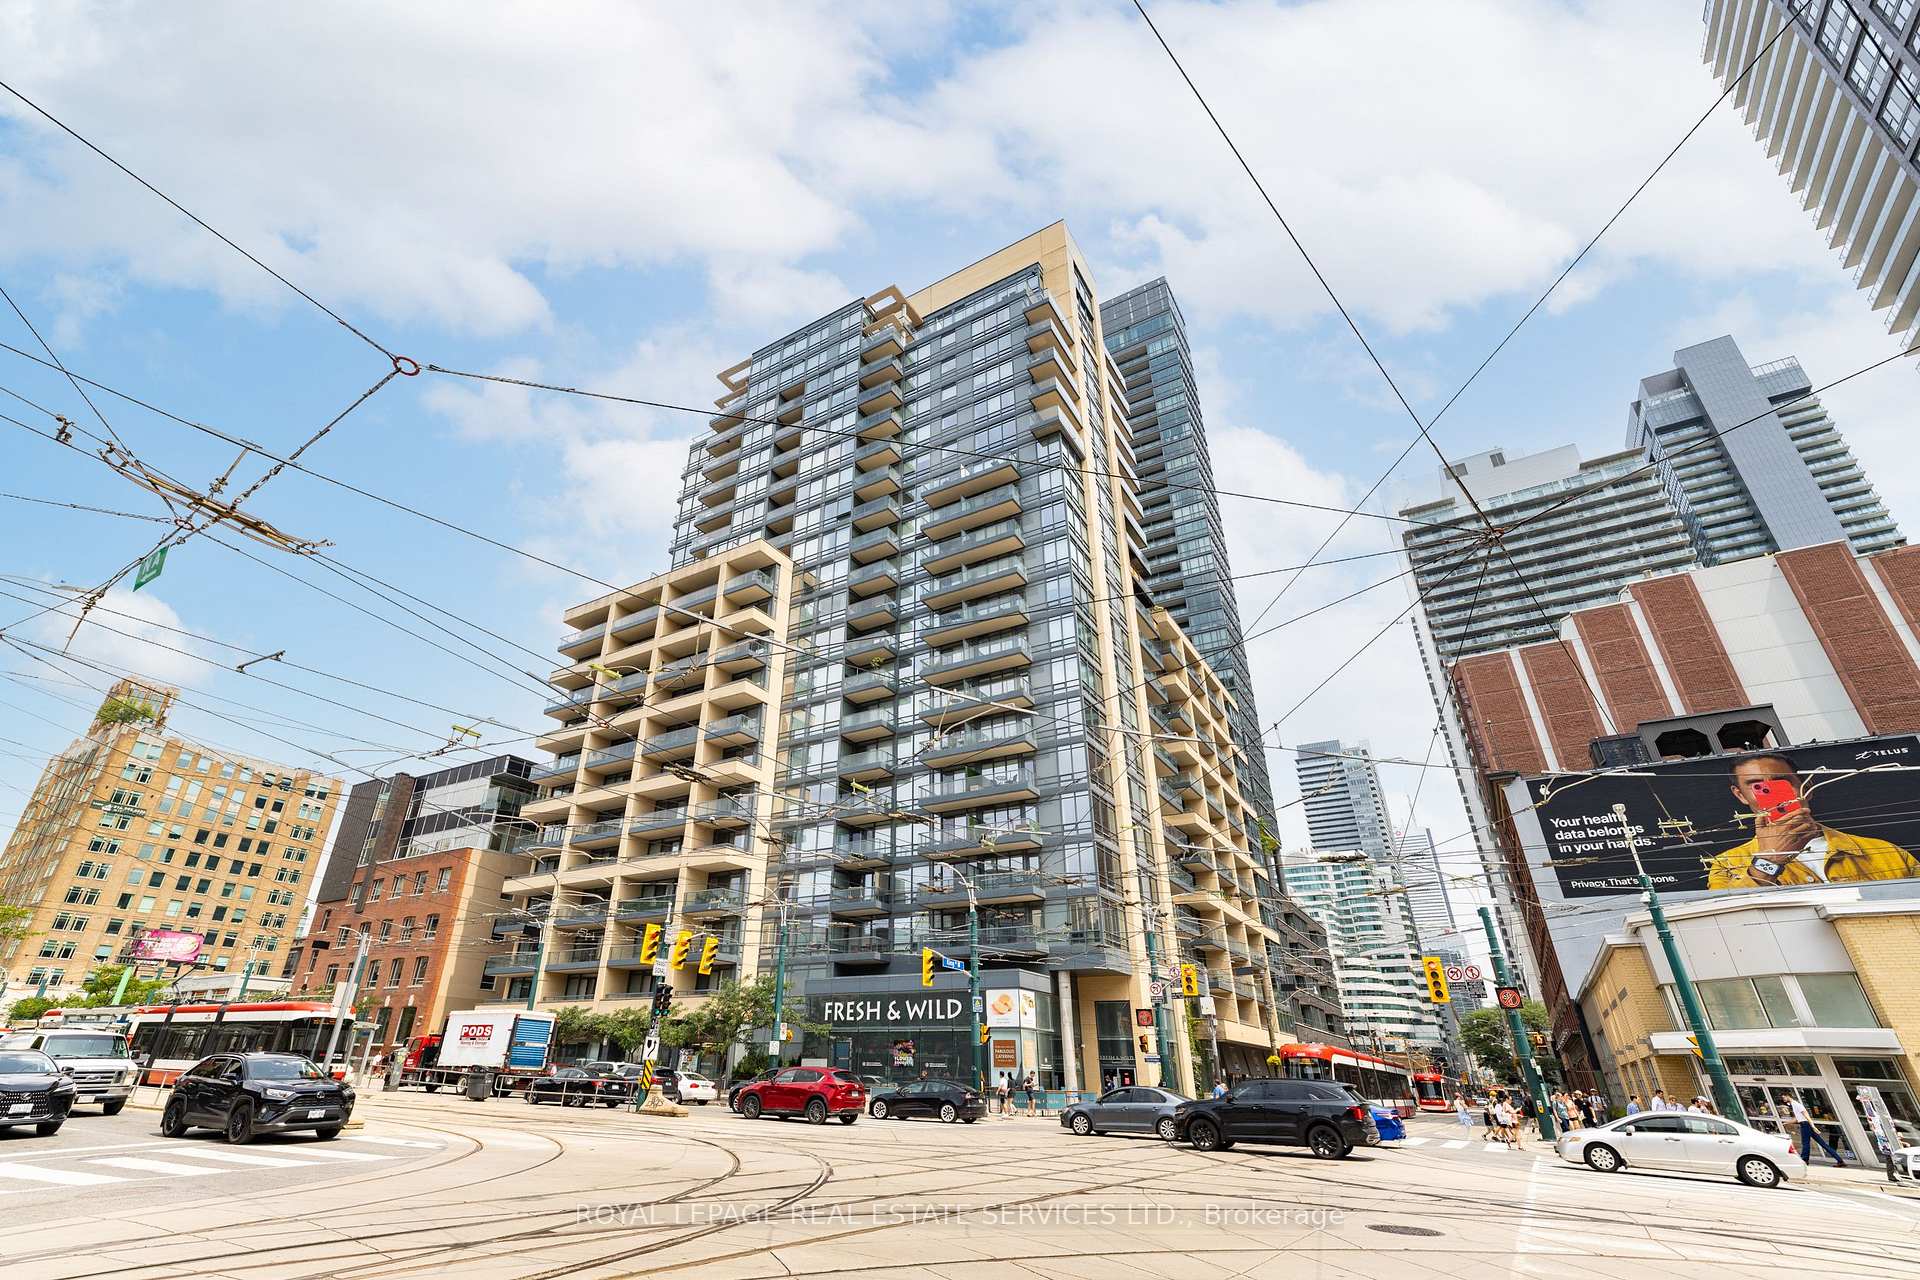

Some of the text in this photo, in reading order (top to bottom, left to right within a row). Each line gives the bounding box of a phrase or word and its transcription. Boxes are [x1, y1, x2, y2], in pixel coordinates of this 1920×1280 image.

[1873, 748, 1909, 756] TELUS
[1550, 816, 1581, 828] Your
[1555, 825, 1645, 841] data belongs
[1559, 843, 1572, 853] in
[1574, 841, 1605, 854] your
[1571, 879, 1608, 889] Privacy.
[1608, 876, 1639, 887] That's
[824, 1000, 881, 1021] FRESH
[887, 1000, 901, 1021] &
[905, 998, 962, 1020] WILD
[461, 1026, 492, 1037] PODS
